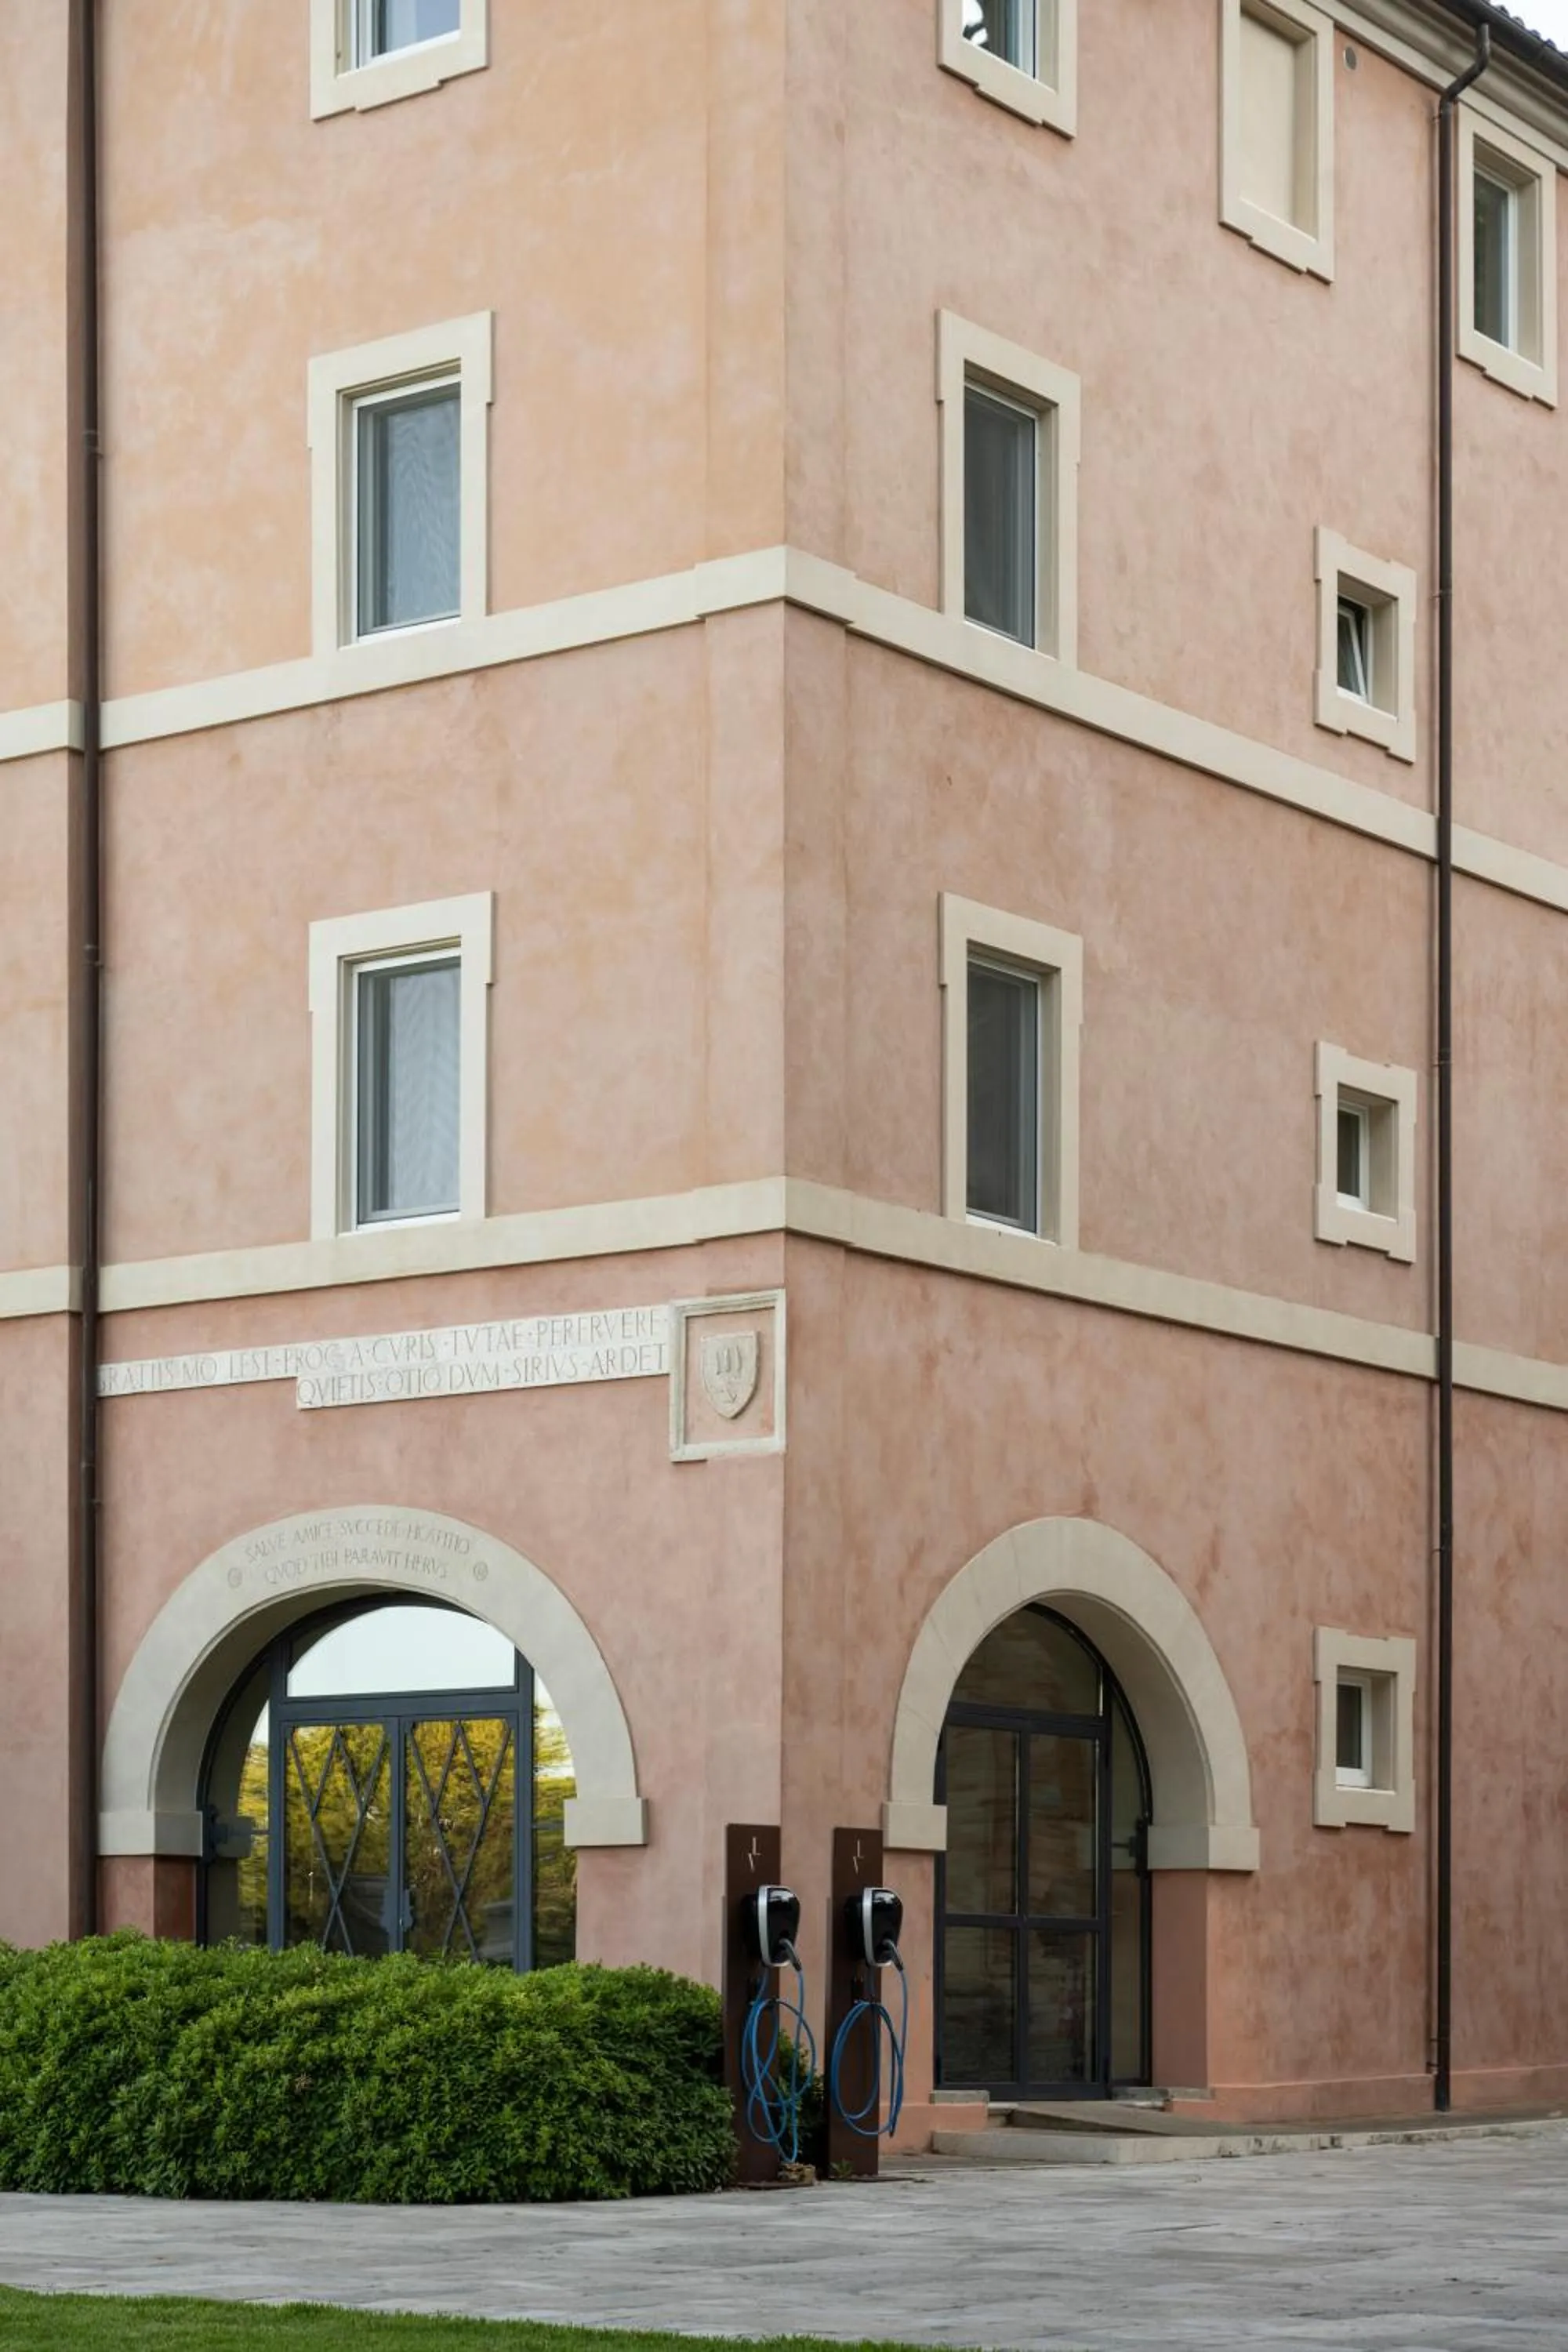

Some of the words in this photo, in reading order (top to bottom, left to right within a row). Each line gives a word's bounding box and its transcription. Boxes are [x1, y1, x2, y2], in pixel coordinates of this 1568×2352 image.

[372, 1332, 435, 1363] CVRIS
[450, 1323, 524, 1356] TVTAE
[297, 1372, 376, 1405] QVIETIS
[386, 1367, 441, 1394] OTIO
[449, 1361, 499, 1391] DVM
[511, 1352, 578, 1382] SIRIVS
[588, 1343, 666, 1376] ARDET
